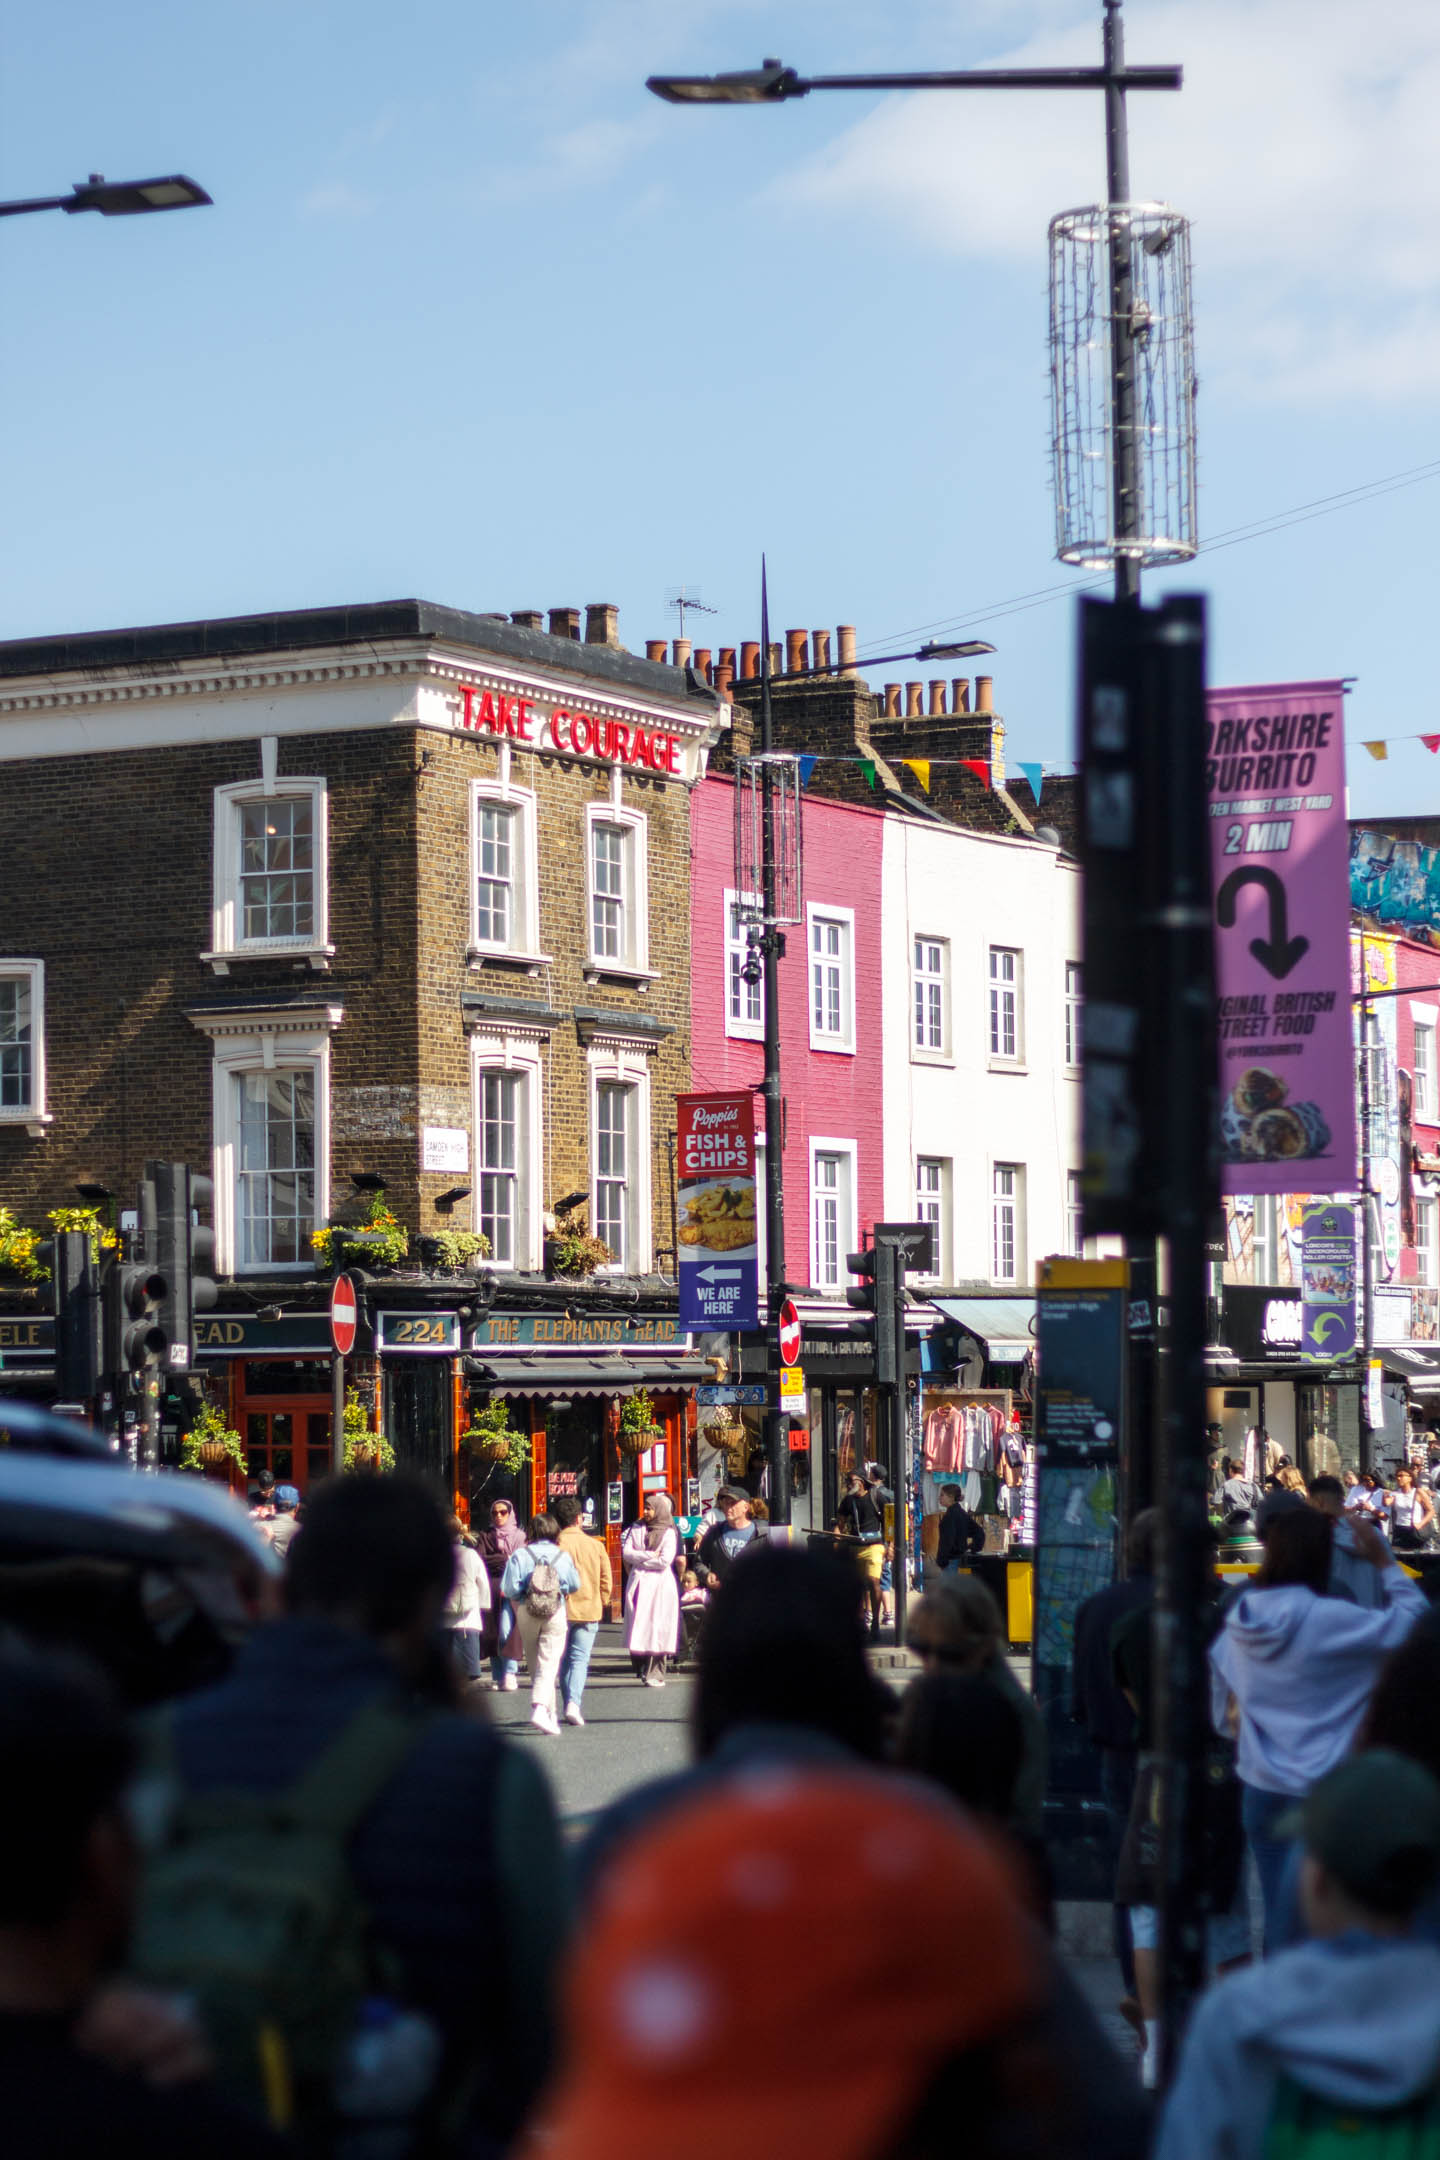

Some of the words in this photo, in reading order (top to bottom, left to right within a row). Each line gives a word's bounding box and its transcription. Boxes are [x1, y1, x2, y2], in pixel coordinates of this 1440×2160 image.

[458, 684, 536, 742] TAKE
[550, 707, 683, 774] COURAGE
[1204, 712, 1334, 756] ORKSHIRE
[1274, 796, 1304, 812] WEST
[1224, 824, 1243, 855] 2
[1245, 820, 1294, 853] MIN
[1273, 991, 1337, 1014] BRITISH
[1273, 1014, 1317, 1036] FOOD
[692, 1105, 738, 1131] Poppies
[686, 1133, 729, 1150] FISH
[735, 1134, 746, 1148] &
[685, 1150, 748, 1168] CHIPS
[696, 1287, 715, 1300] WE
[718, 1287, 741, 1300] ARE
[703, 1301, 734, 1315] HERE
[194, 1322, 245, 1345] EAD
[396, 1320, 447, 1343] 224
[488, 1320, 519, 1342] THE
[532, 1320, 622, 1342] ELEPHANTS
[633, 1320, 676, 1342] HEAD
[792, 1432, 808, 1447] LE
